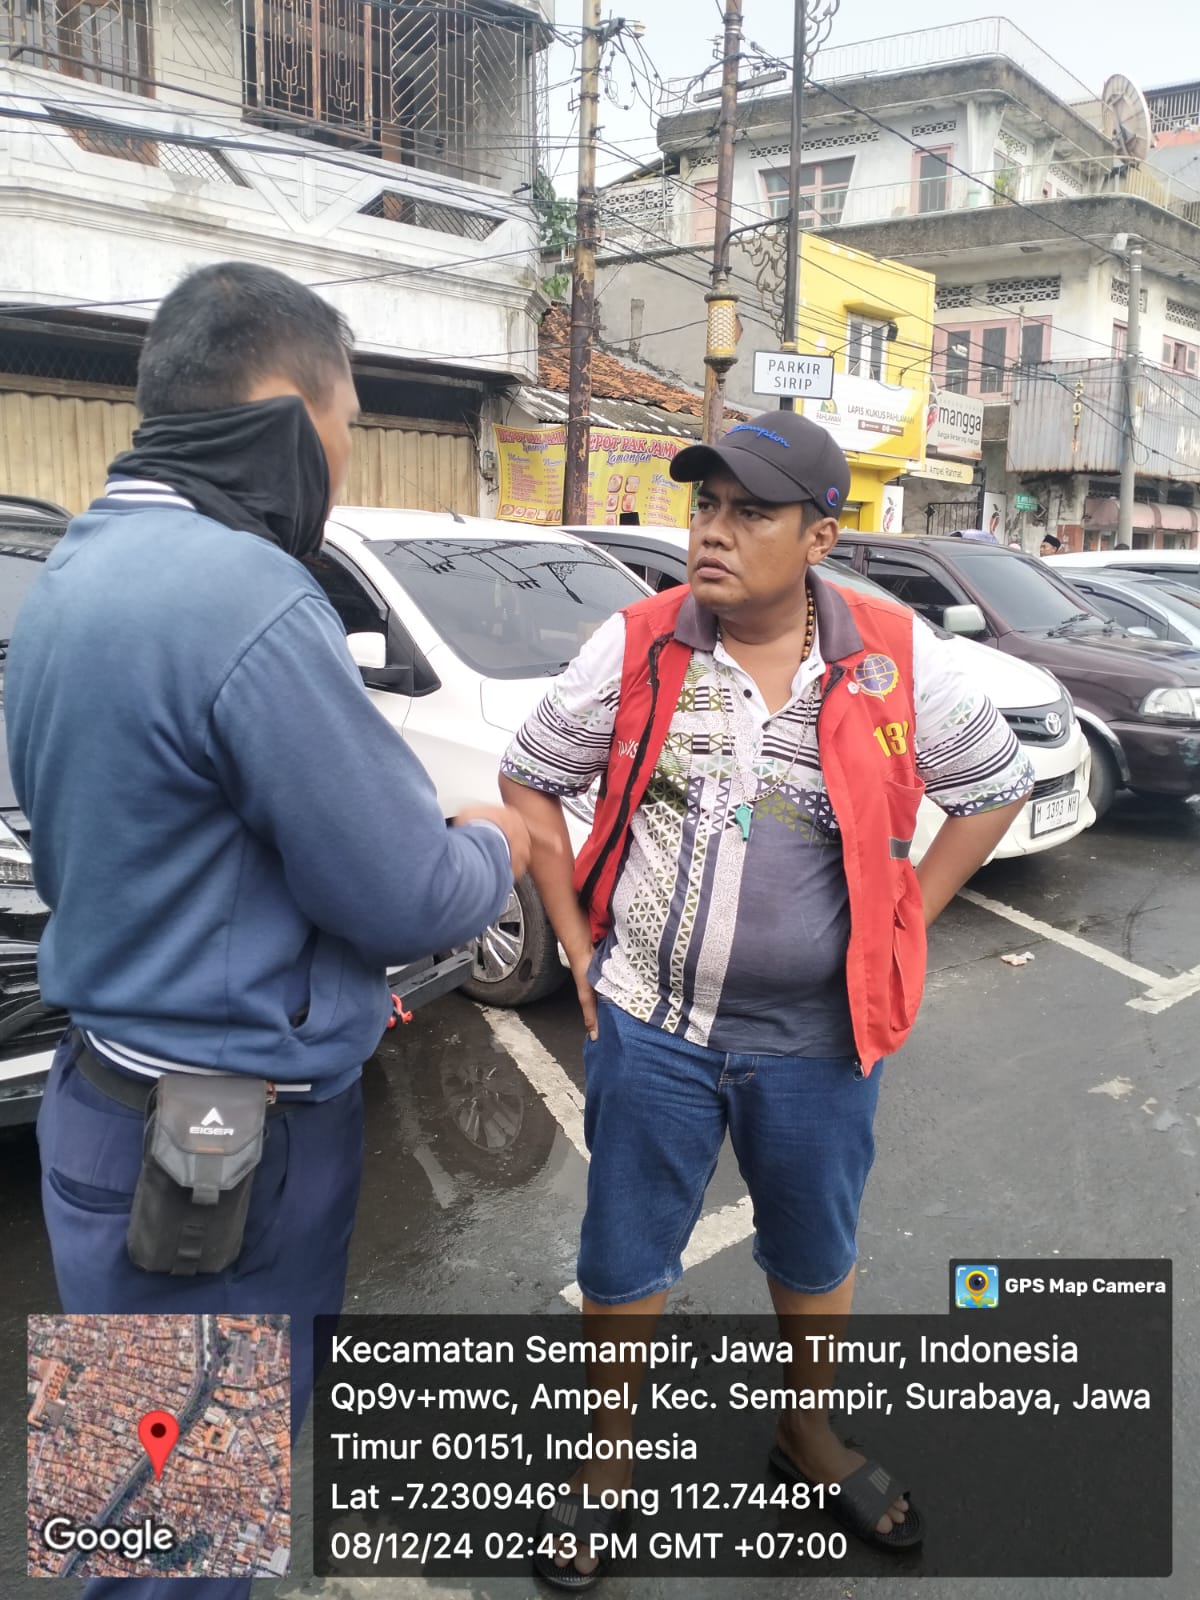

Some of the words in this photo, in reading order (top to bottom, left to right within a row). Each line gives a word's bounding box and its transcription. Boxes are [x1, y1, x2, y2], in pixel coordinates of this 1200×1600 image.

[768, 359, 821, 376] PARKIR
[774, 376, 813, 391] SIRIP
[847, 404, 864, 416] LAPIS
[865, 408, 886, 420] KUKUS
[886, 411, 915, 425] PAHLAWAN
[938, 406, 982, 436] mangga
[588, 432, 621, 452] EPOT
[621, 435, 647, 453] PAK
[606, 450, 652, 467] Lamongan
[1046, 799, 1064, 820] 1393
[189, 1126, 235, 1136] EIGER
